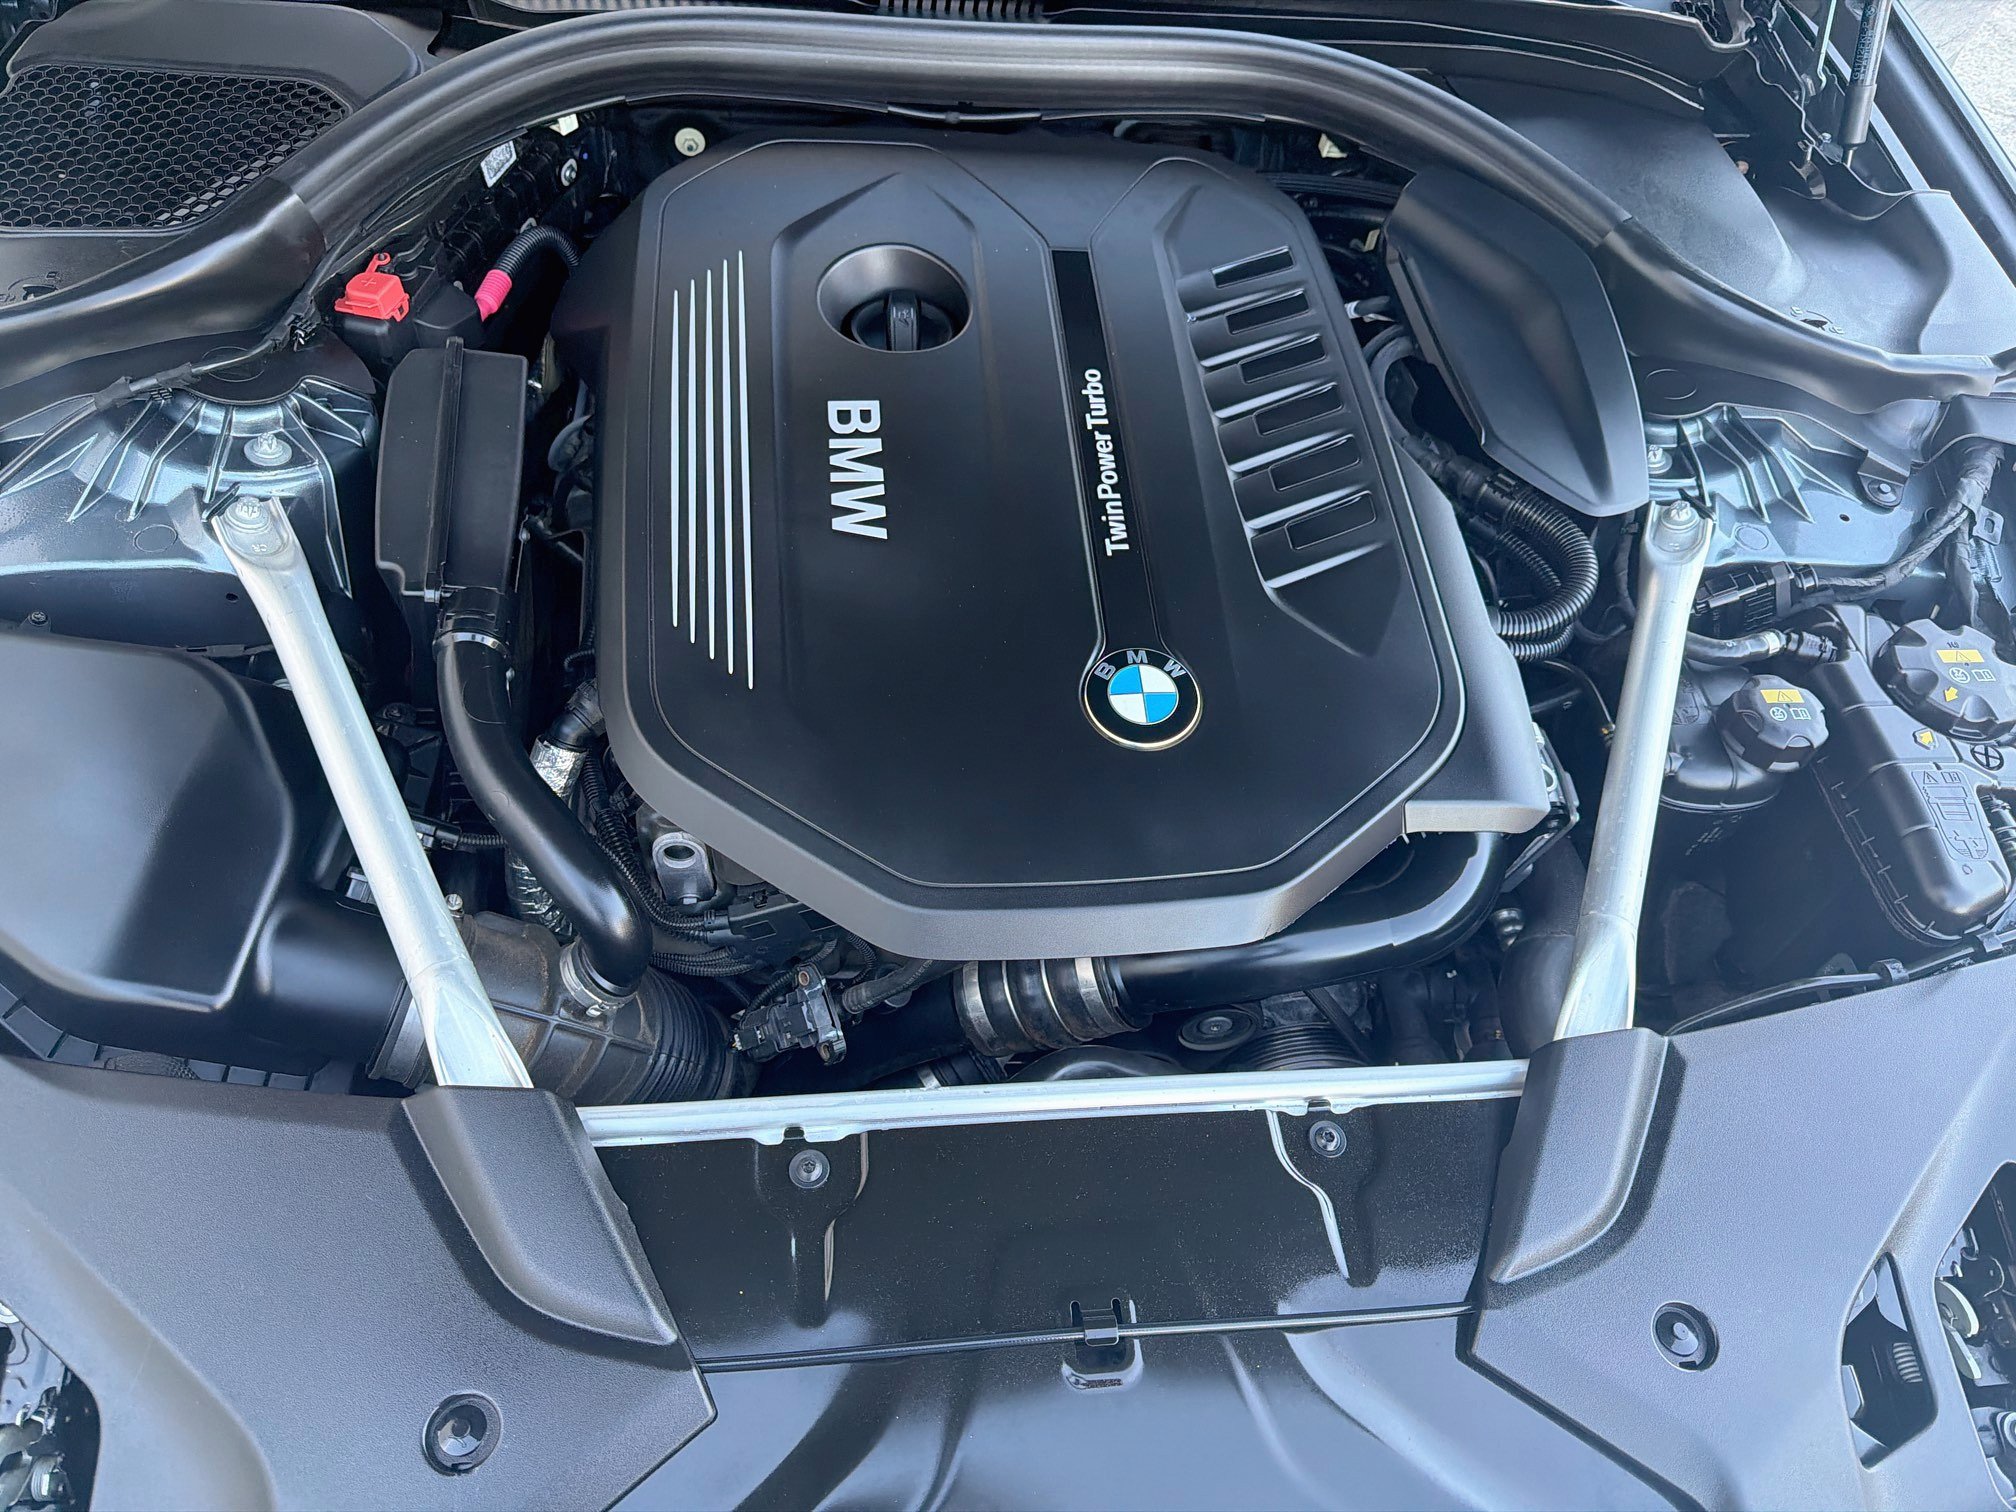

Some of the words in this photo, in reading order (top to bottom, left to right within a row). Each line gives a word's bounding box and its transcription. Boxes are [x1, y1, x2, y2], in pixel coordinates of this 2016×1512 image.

[1081, 368, 1109, 430] Turbo
[827, 400, 888, 540] BMW
[1094, 430, 1130, 556] TwinPower
[1094, 650, 1186, 680] BMW
